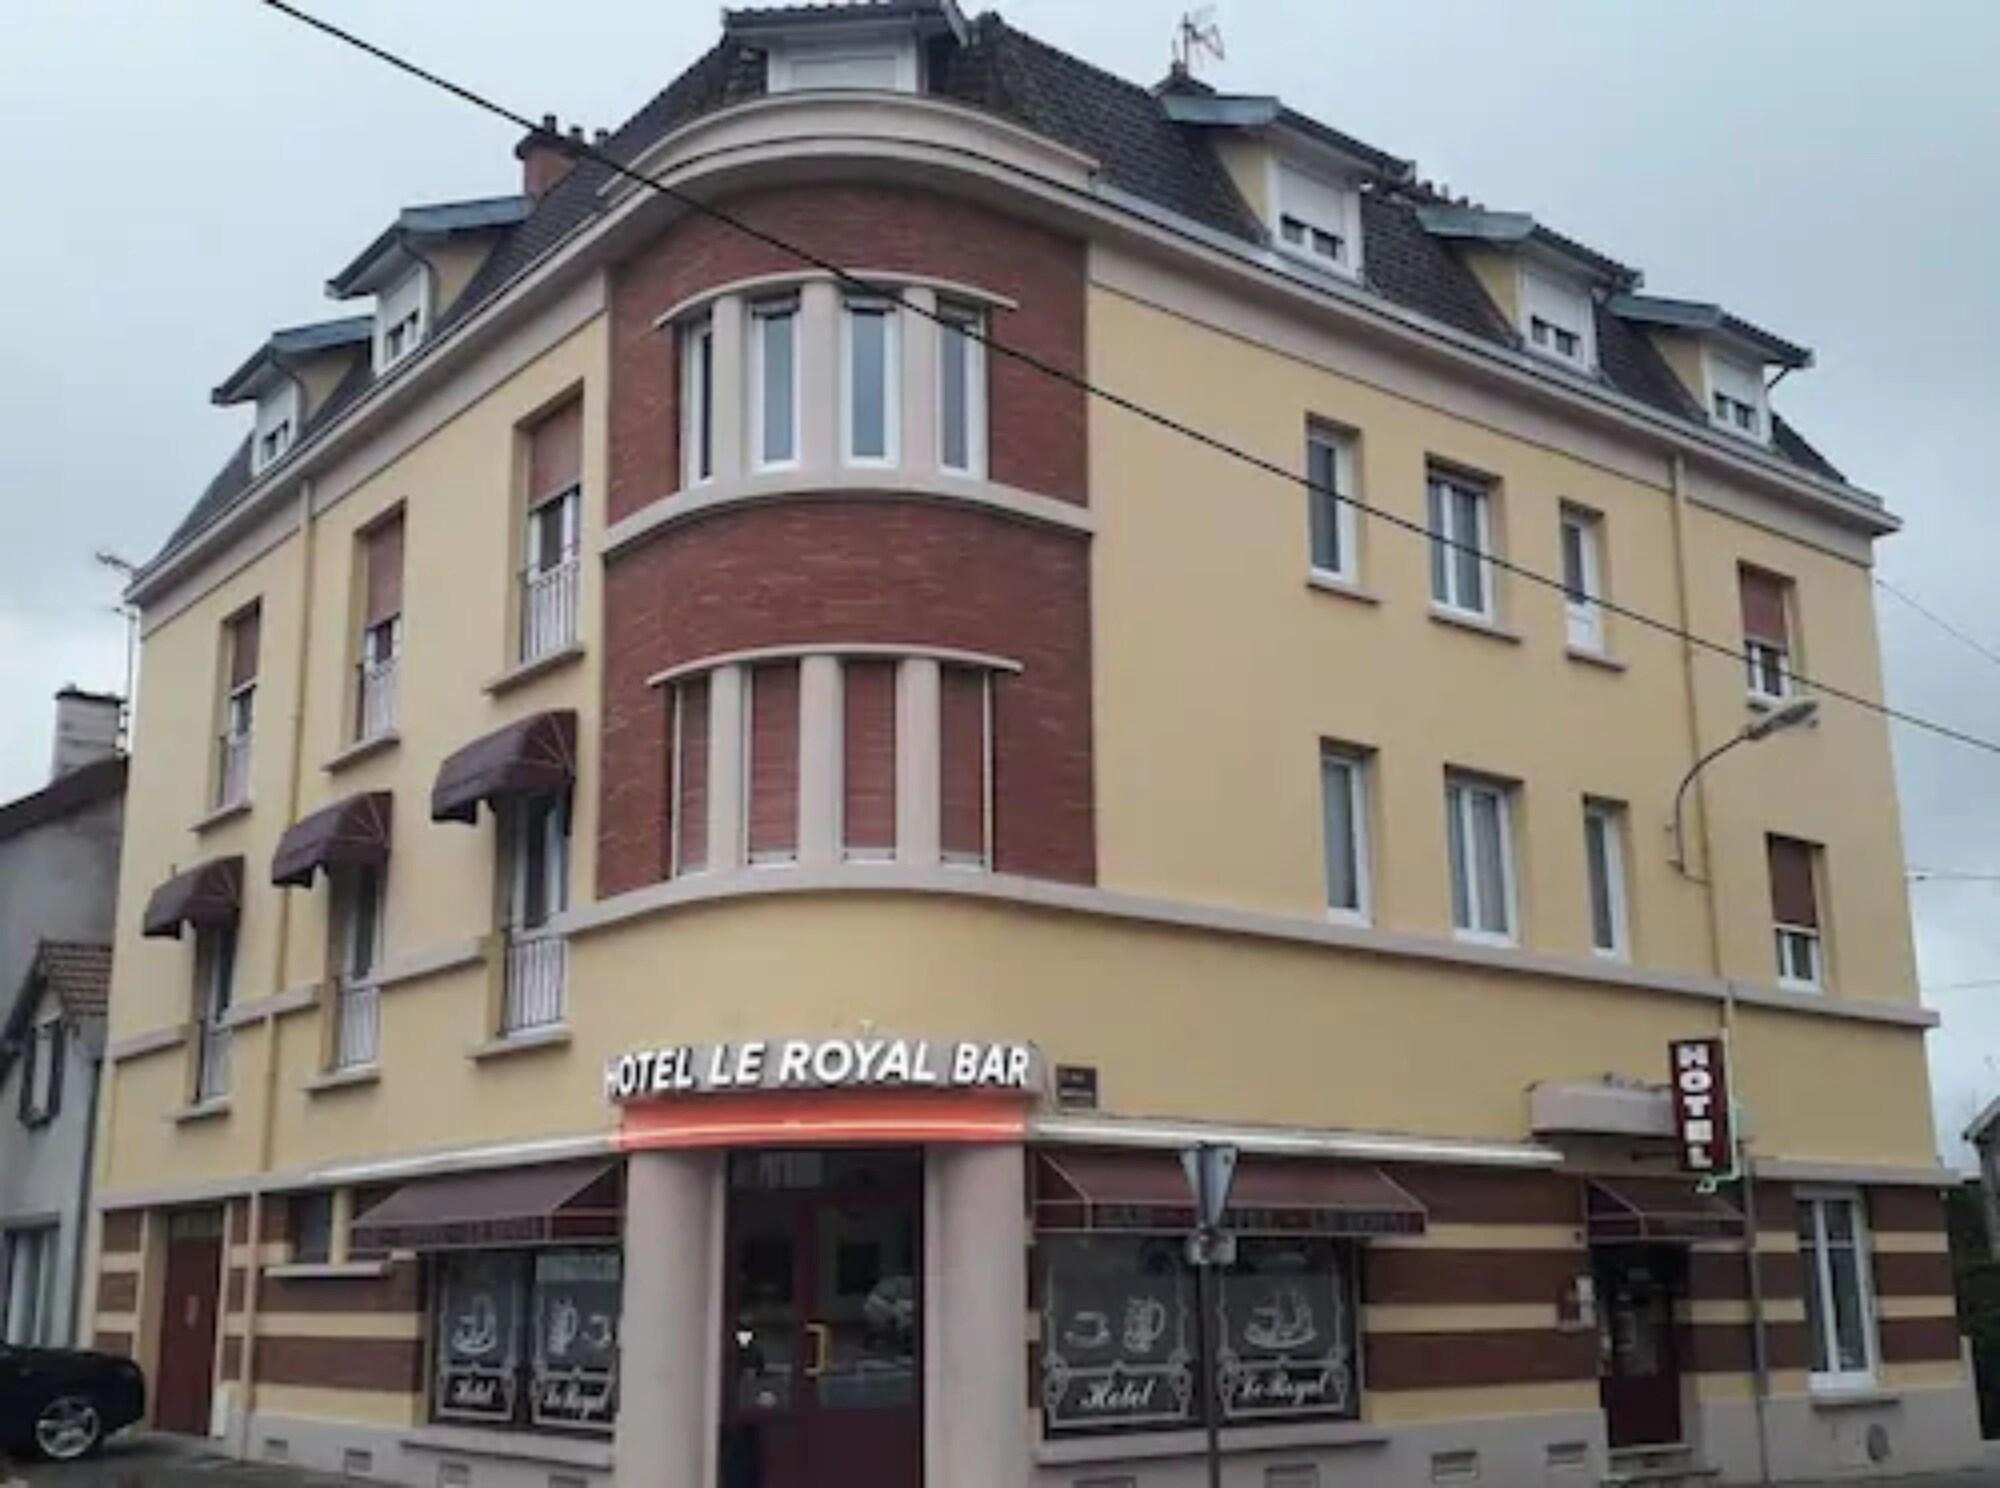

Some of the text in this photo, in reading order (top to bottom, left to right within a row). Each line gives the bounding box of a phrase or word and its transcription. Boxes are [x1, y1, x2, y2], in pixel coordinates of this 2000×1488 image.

[708, 1041, 766, 1086] LE
[779, 1038, 938, 1084] ROYAL
[952, 1041, 1029, 1086] BAR
[1676, 1043, 1715, 1169] HOTEL
